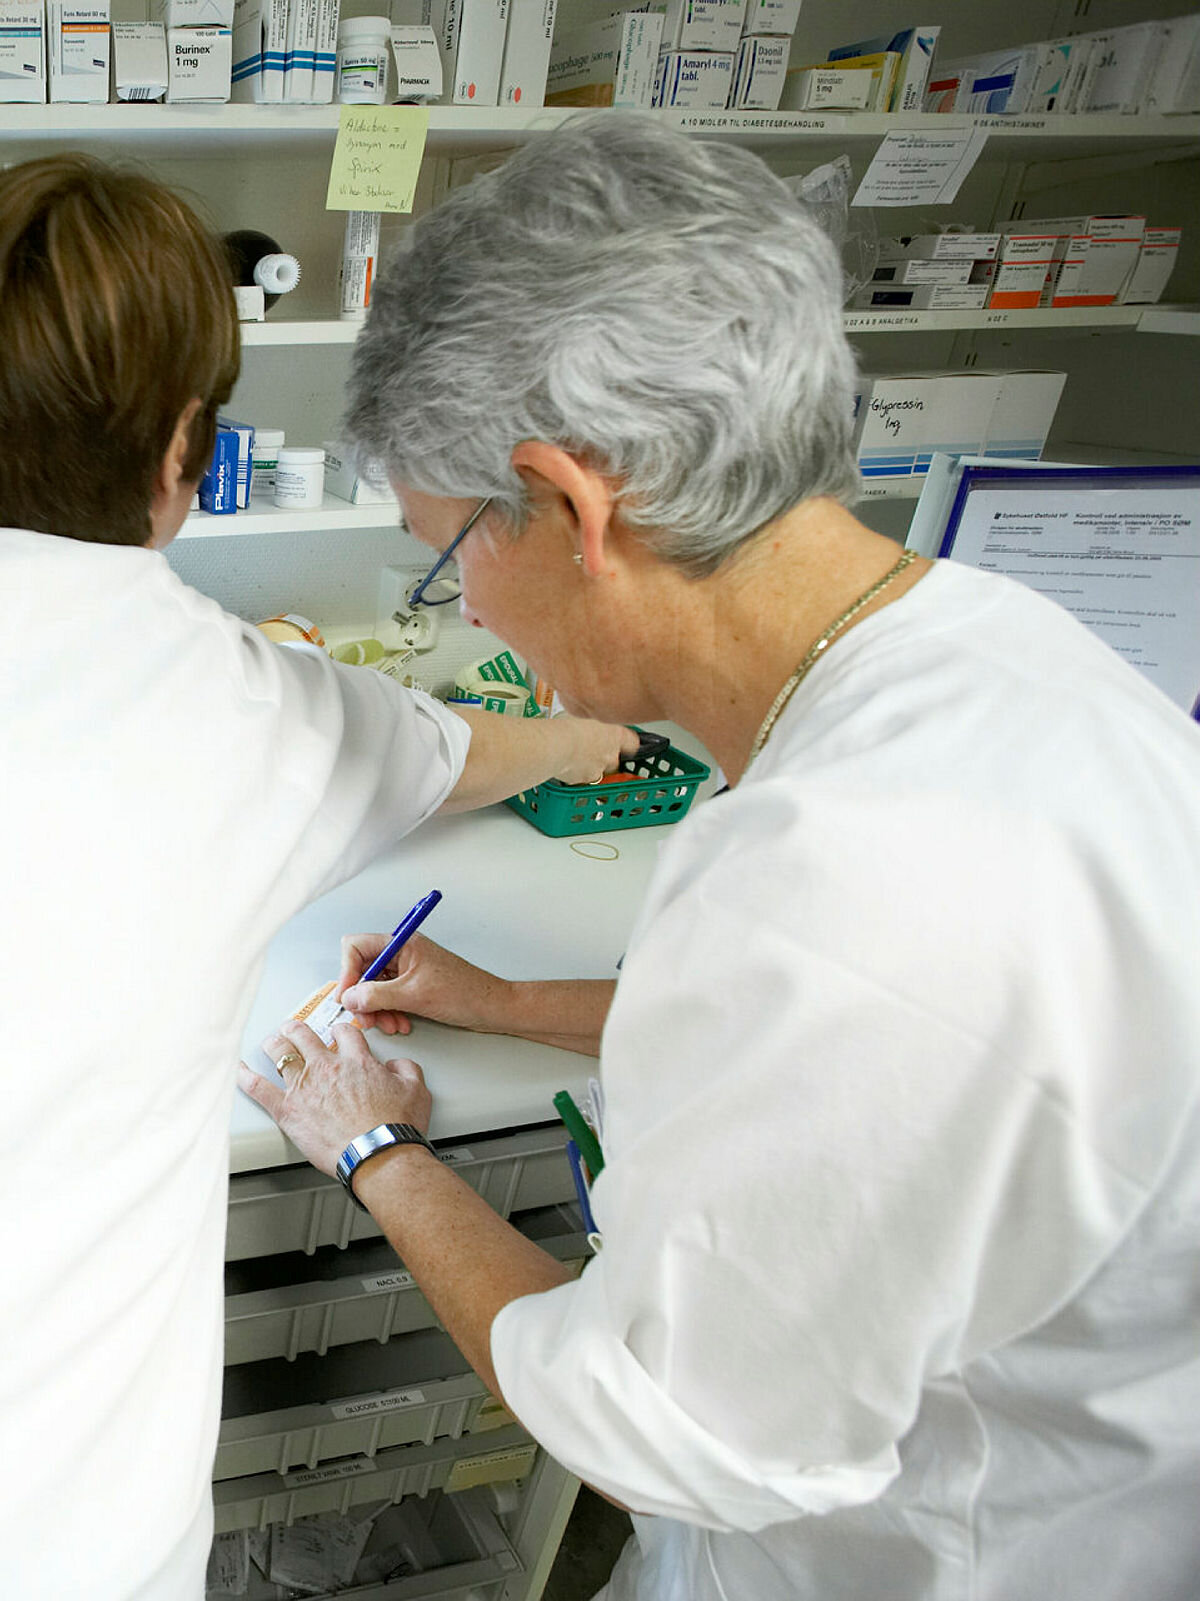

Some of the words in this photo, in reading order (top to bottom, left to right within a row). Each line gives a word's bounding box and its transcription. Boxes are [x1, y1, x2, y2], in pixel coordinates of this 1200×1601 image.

[175, 45, 210, 54] Burinex
[758, 46, 783, 56] Daonil
[183, 59, 198, 68] mg
[712, 59, 718, 68] 4
[718, 61, 731, 72] mg
[681, 69, 700, 81] tabl.
[822, 85, 833, 94] mg
[699, 119, 728, 127] MIDLER
[729, 119, 741, 127] TIL
[871, 398, 925, 419] Glypressin
[214, 464, 225, 511] Plavix
